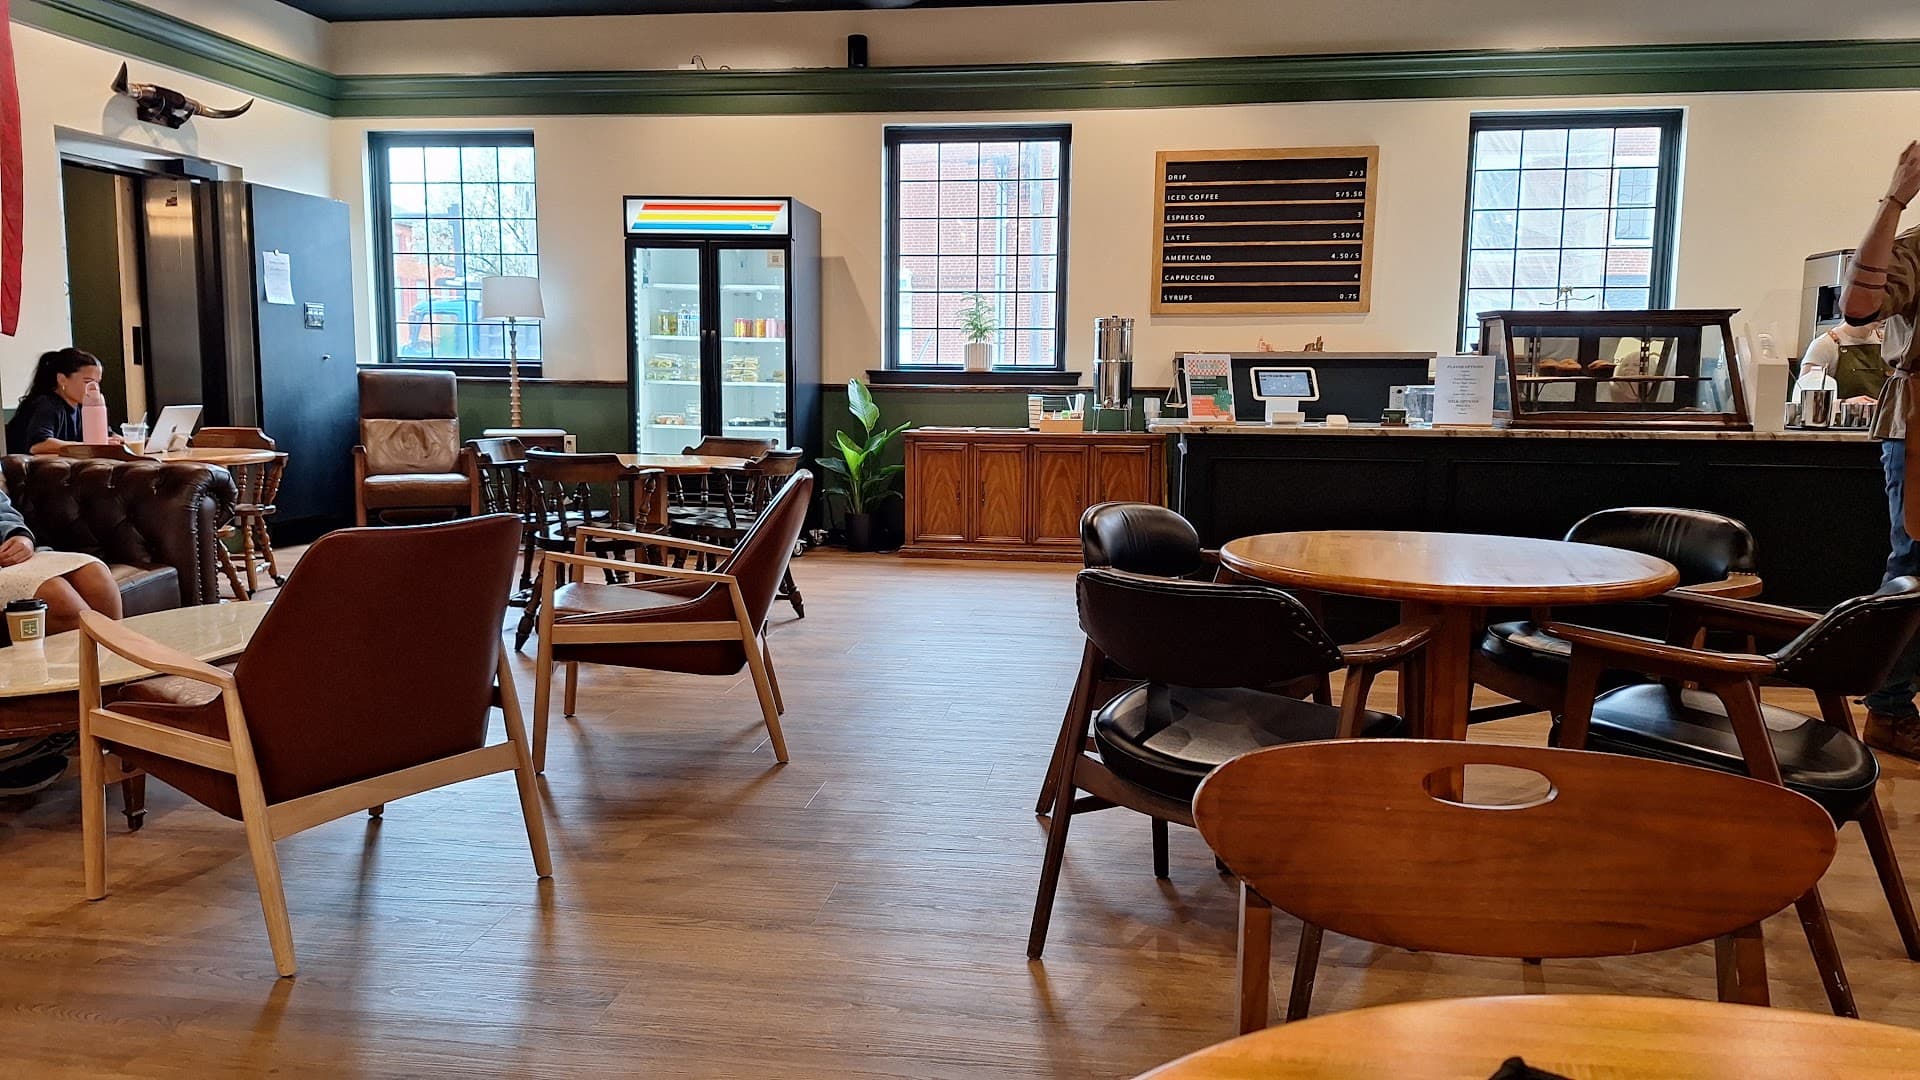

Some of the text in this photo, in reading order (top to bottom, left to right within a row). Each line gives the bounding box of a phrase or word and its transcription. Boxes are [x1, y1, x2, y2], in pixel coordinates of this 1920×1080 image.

[1188, 193, 1219, 201] COFFEE
[1335, 190, 1363, 198] 5/5.50
[1332, 231, 1361, 239] 5.50/6
